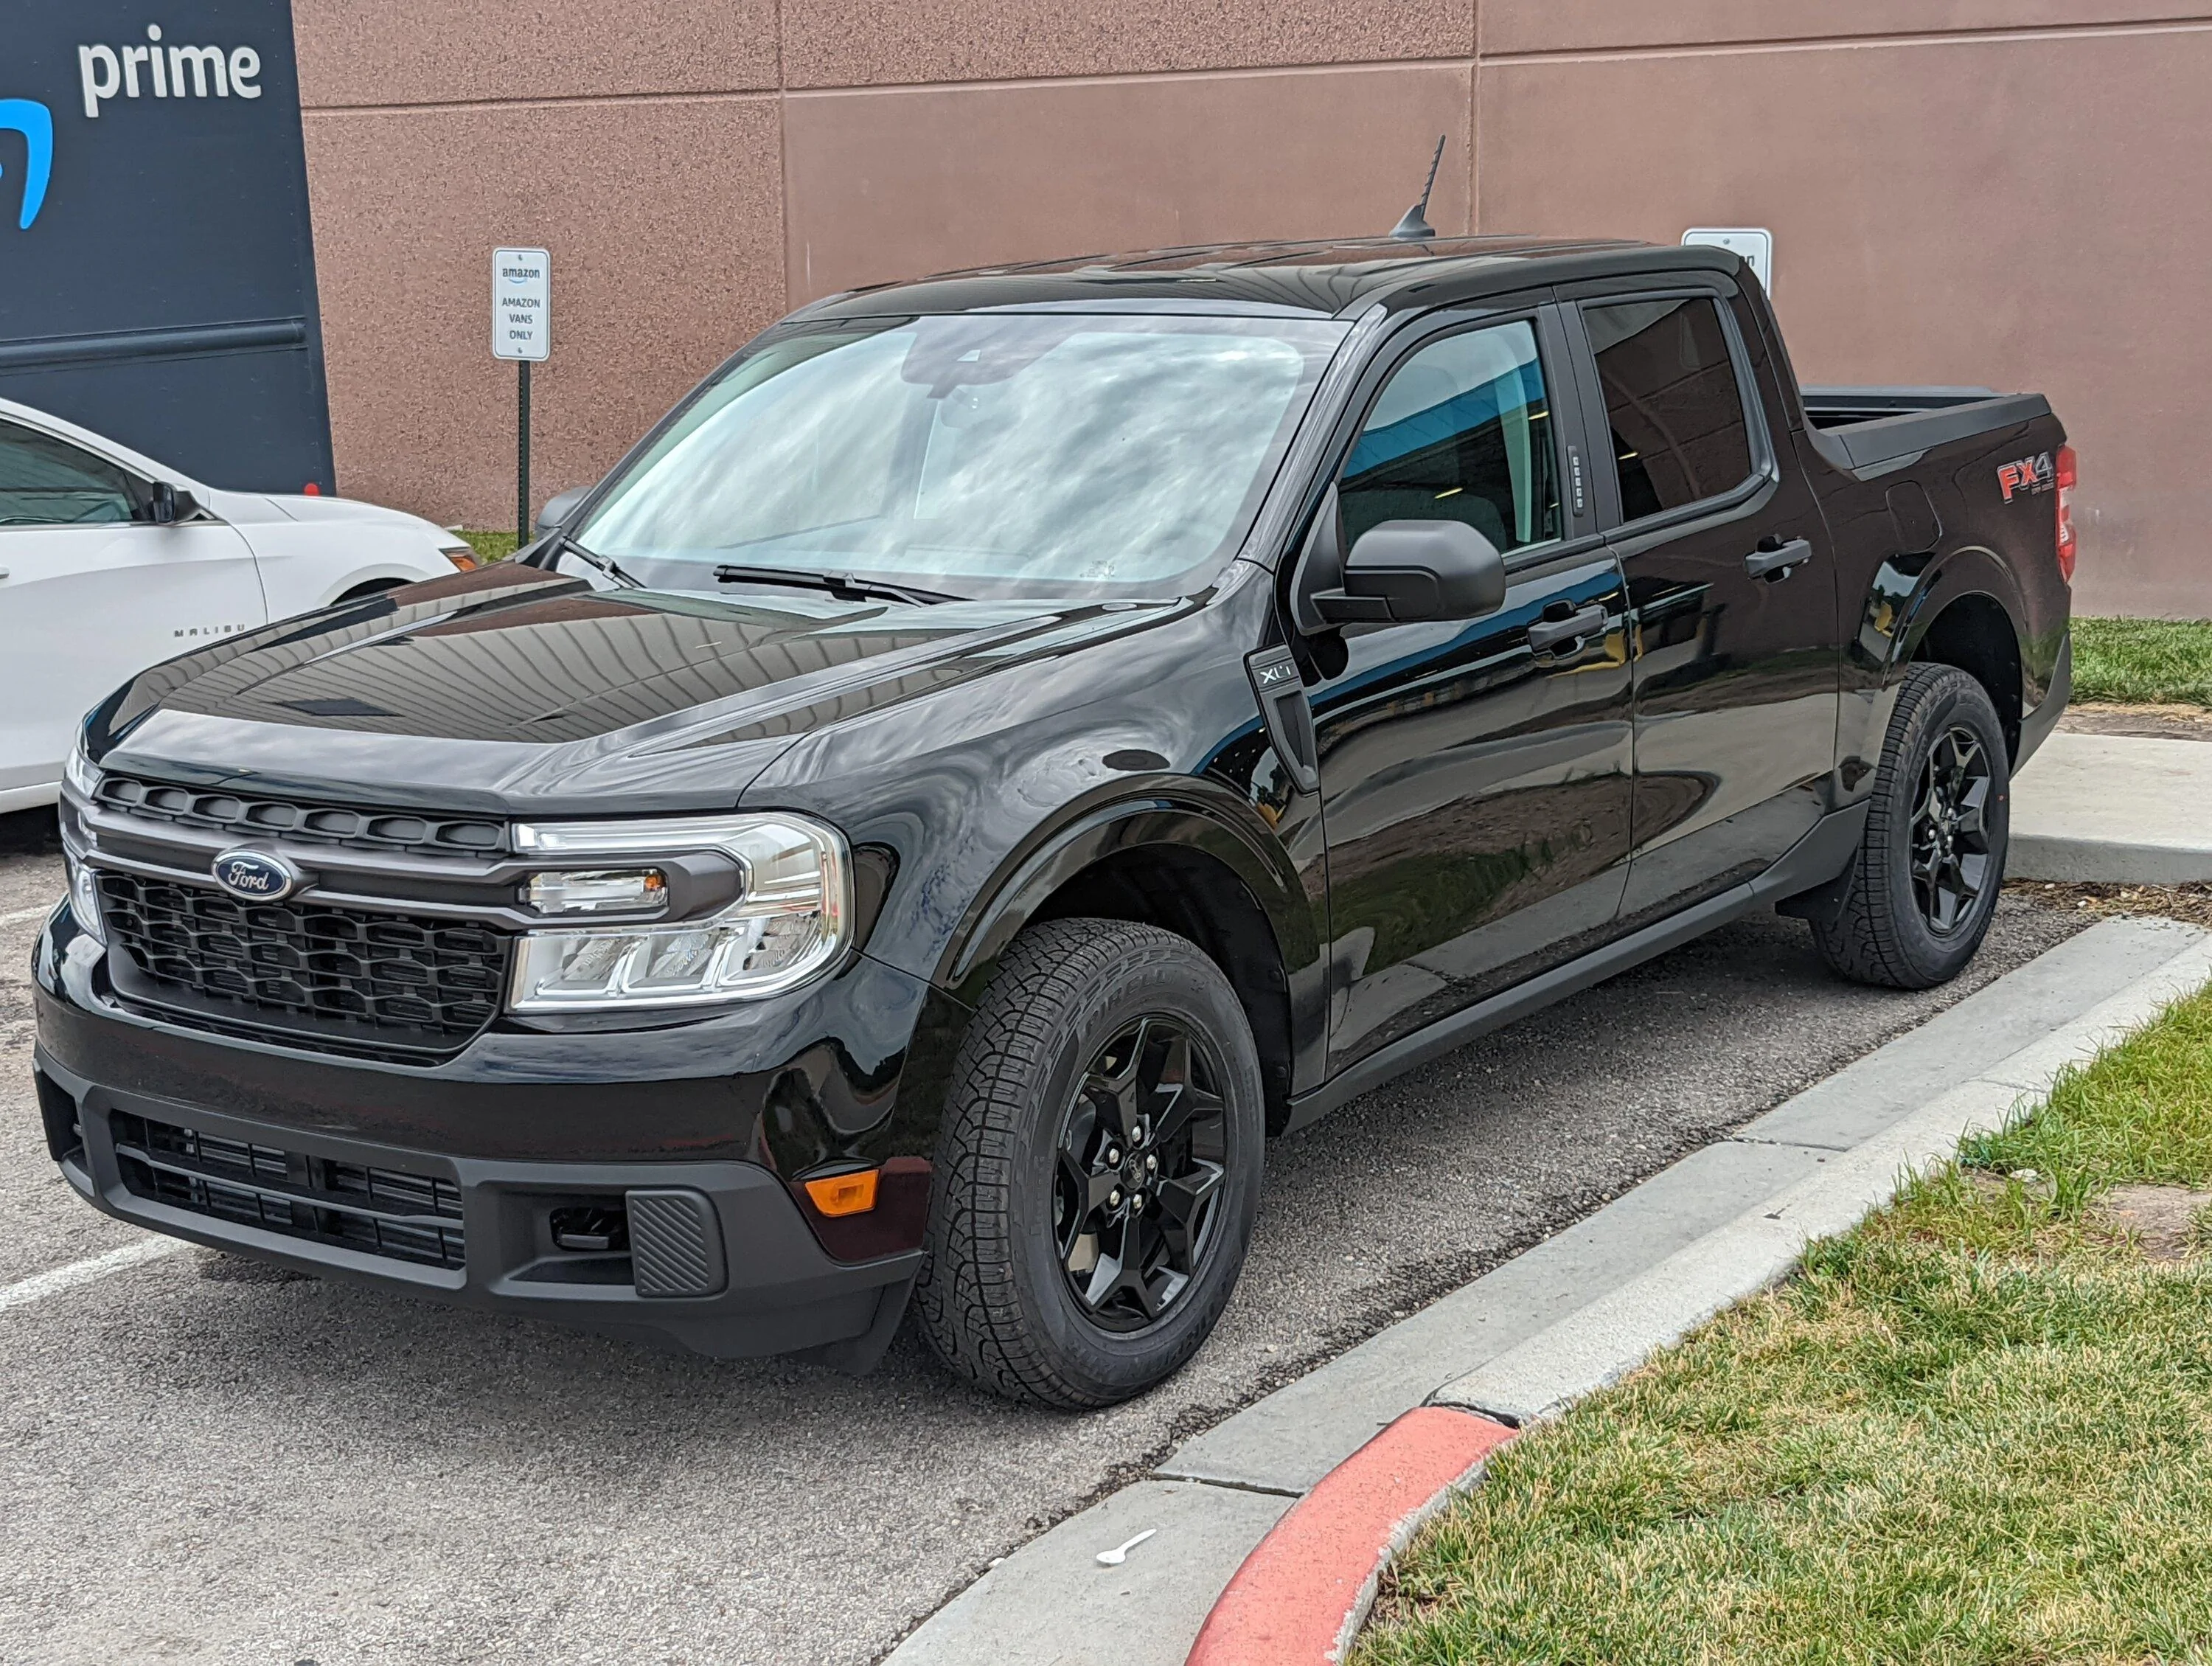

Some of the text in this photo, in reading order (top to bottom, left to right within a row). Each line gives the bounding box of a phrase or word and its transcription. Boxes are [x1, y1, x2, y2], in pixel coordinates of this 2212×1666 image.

[79, 24, 261, 118] prime
[502, 268, 540, 279] amazon
[501, 297, 540, 308] AMAZON
[509, 313, 533, 324] VANS
[509, 330, 533, 341] ONLY
[1997, 451, 2054, 504] FX4
[174, 624, 245, 638] MALIBU
[227, 861, 270, 891] Ford
